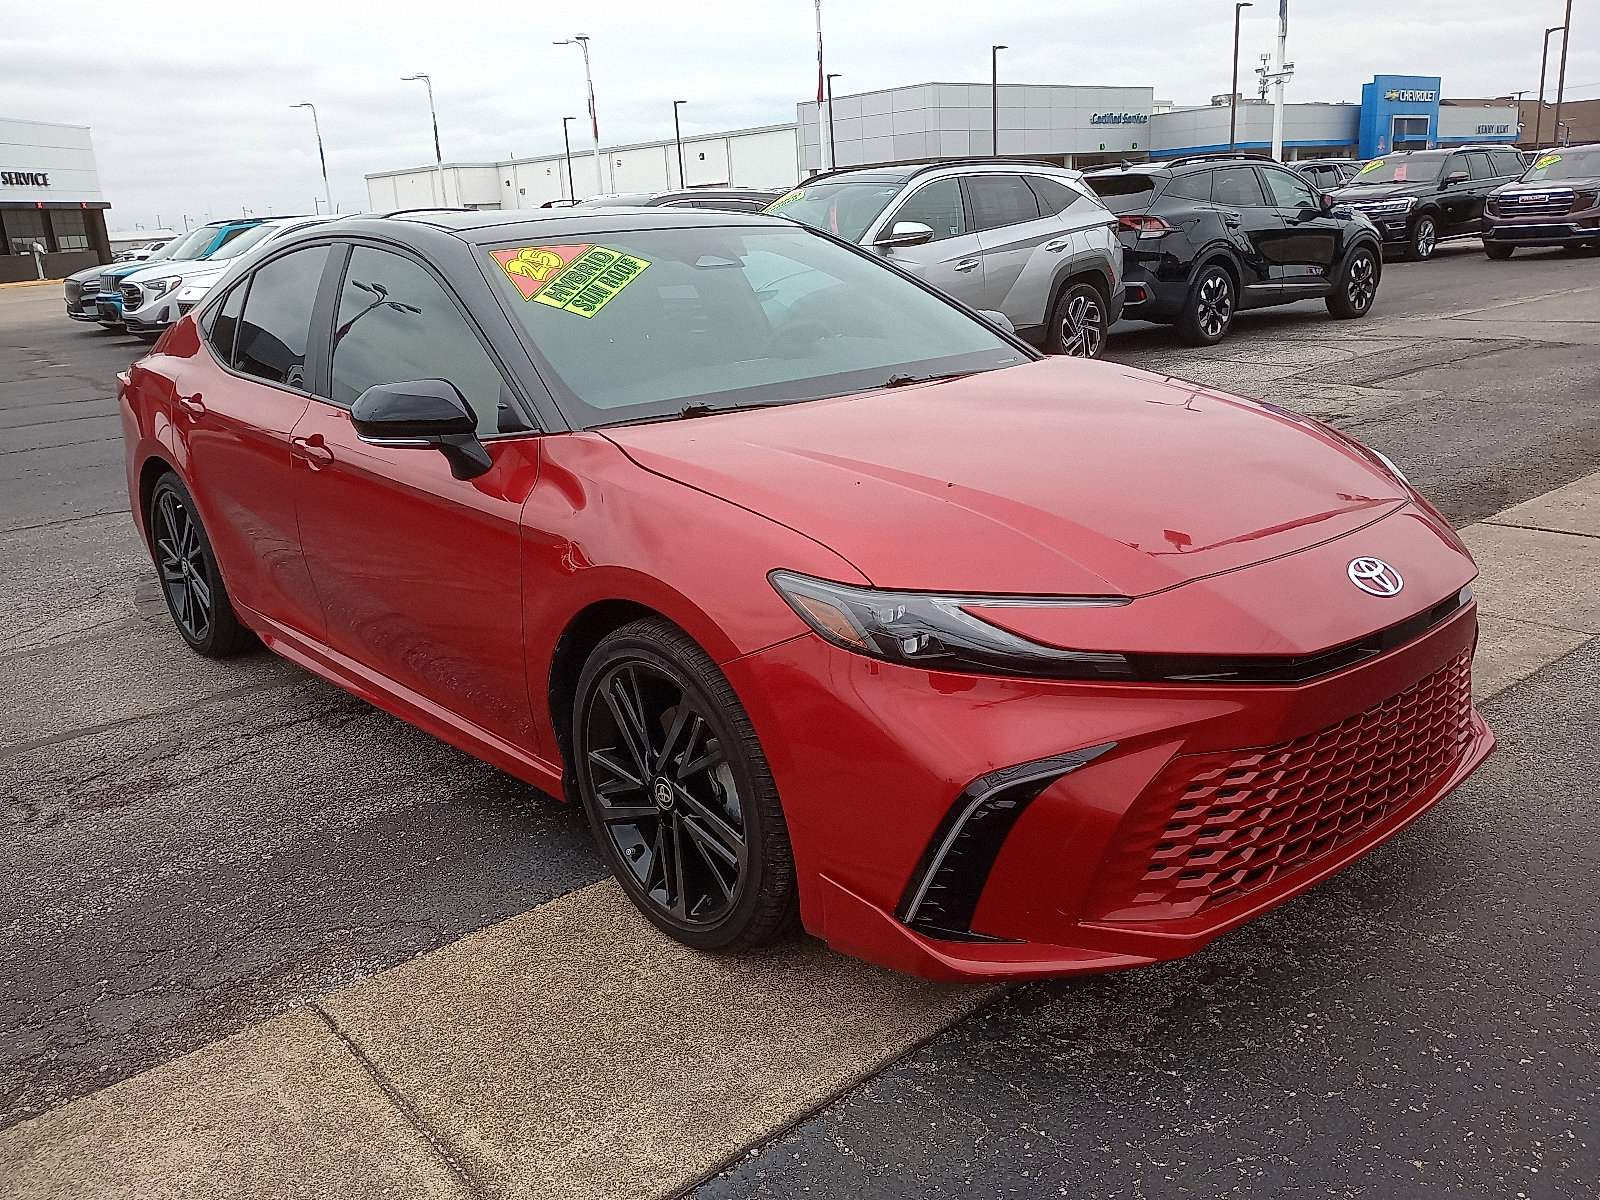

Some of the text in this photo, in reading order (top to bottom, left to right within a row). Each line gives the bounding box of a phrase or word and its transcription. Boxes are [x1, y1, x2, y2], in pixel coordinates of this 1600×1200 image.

[1400, 90, 1436, 101] CHEVROLET
[1091, 112, 1148, 124] Certified Service
[1, 171, 51, 186] SERVICE
[505, 248, 564, 282] 25
[543, 251, 614, 302] HYBRID
[571, 257, 641, 312] SUN ROOF
